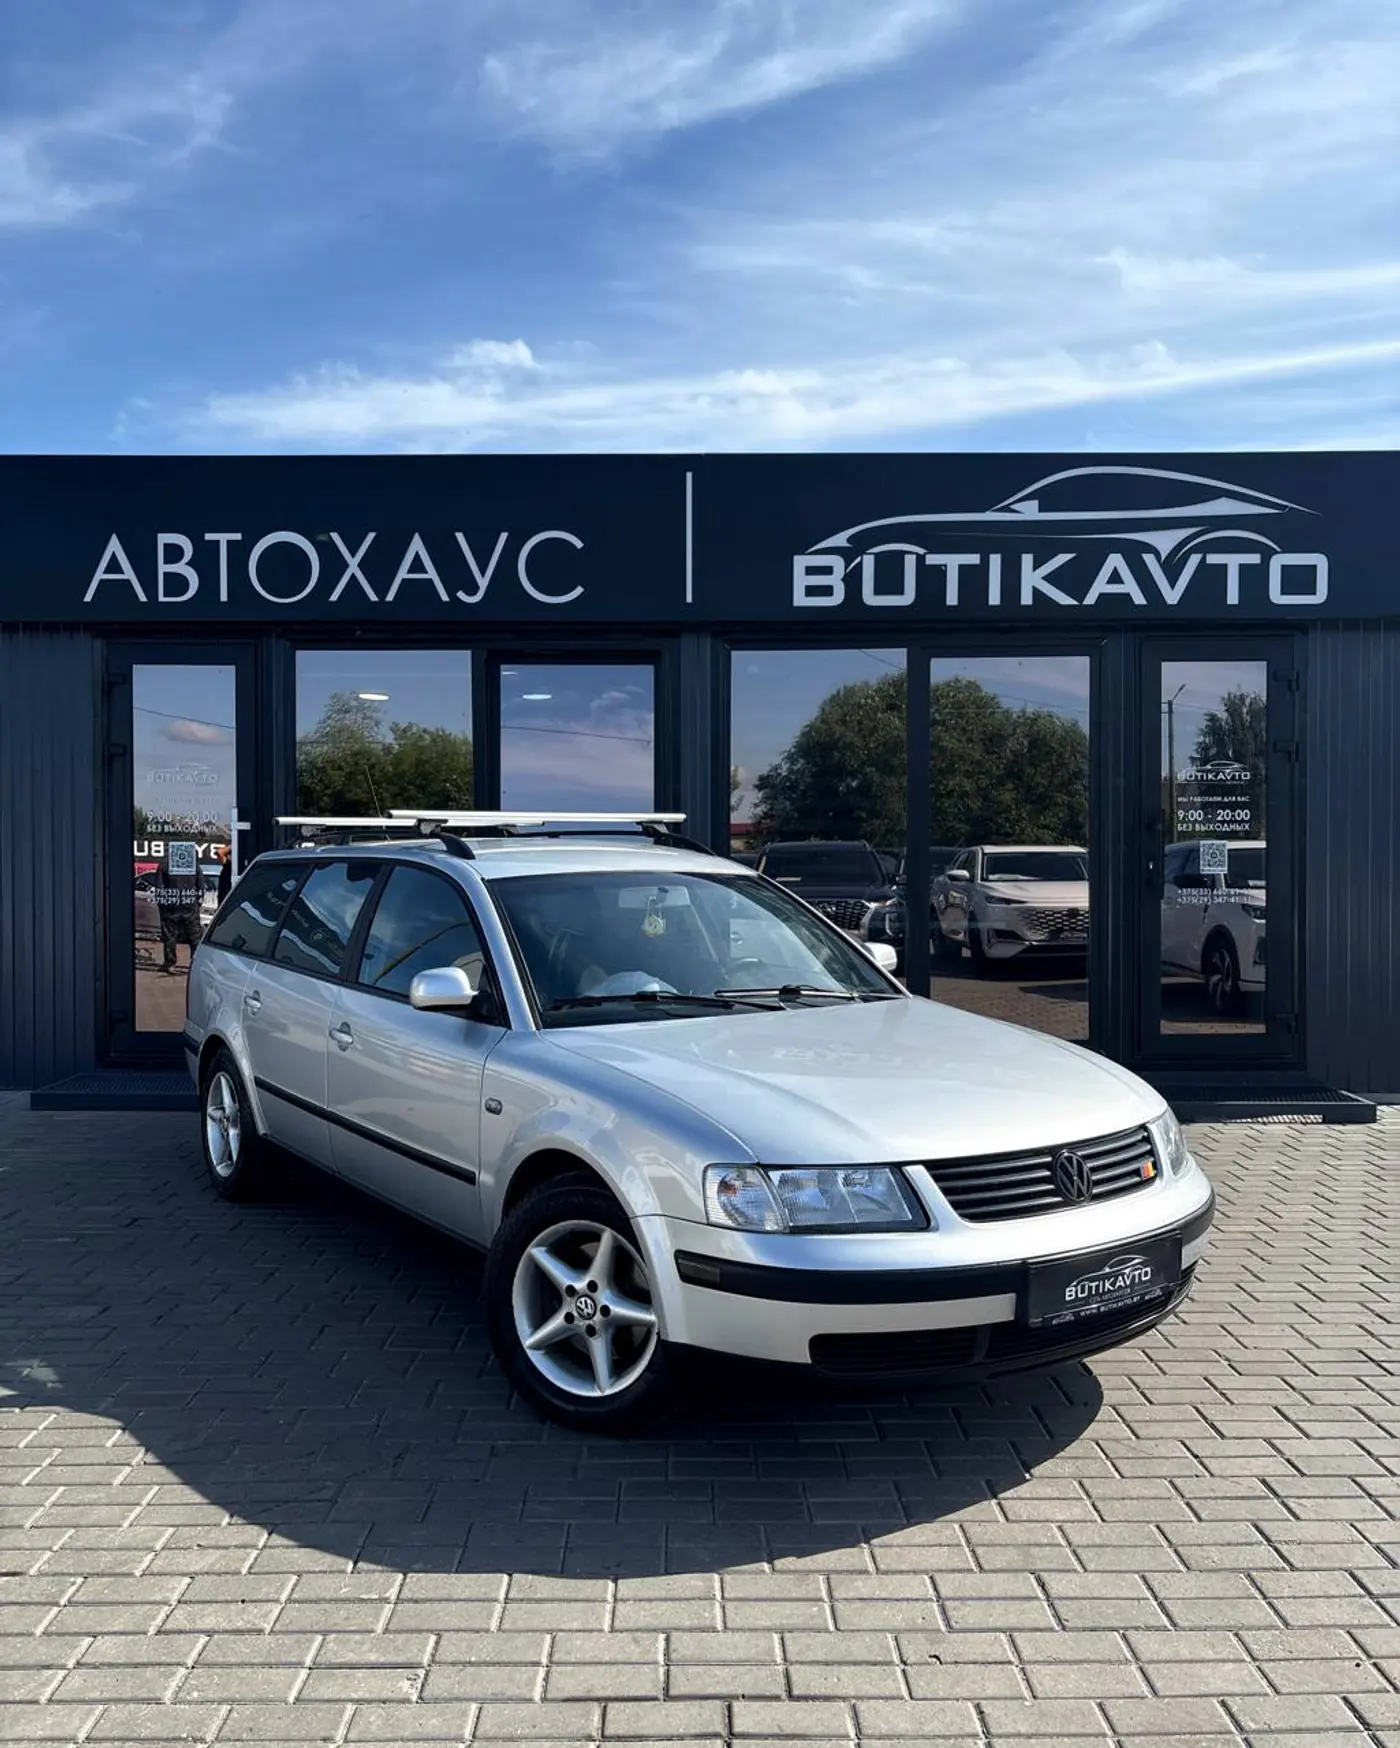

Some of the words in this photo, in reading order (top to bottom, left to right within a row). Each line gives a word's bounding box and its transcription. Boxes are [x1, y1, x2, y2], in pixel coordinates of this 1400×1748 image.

[83, 530, 585, 604] АВТОХАУС
[792, 552, 1329, 607] BUTIKAVTO
[1177, 771, 1251, 781] BUTIKAVTO
[1177, 809, 1204, 821] 9:00
[1216, 809, 1251, 821] 20:00
[1177, 823, 1192, 832] БЕЗ
[1195, 823, 1250, 832] ВЫХОДНЫХ
[1064, 1266, 1152, 1301] BUTIKAVTO
